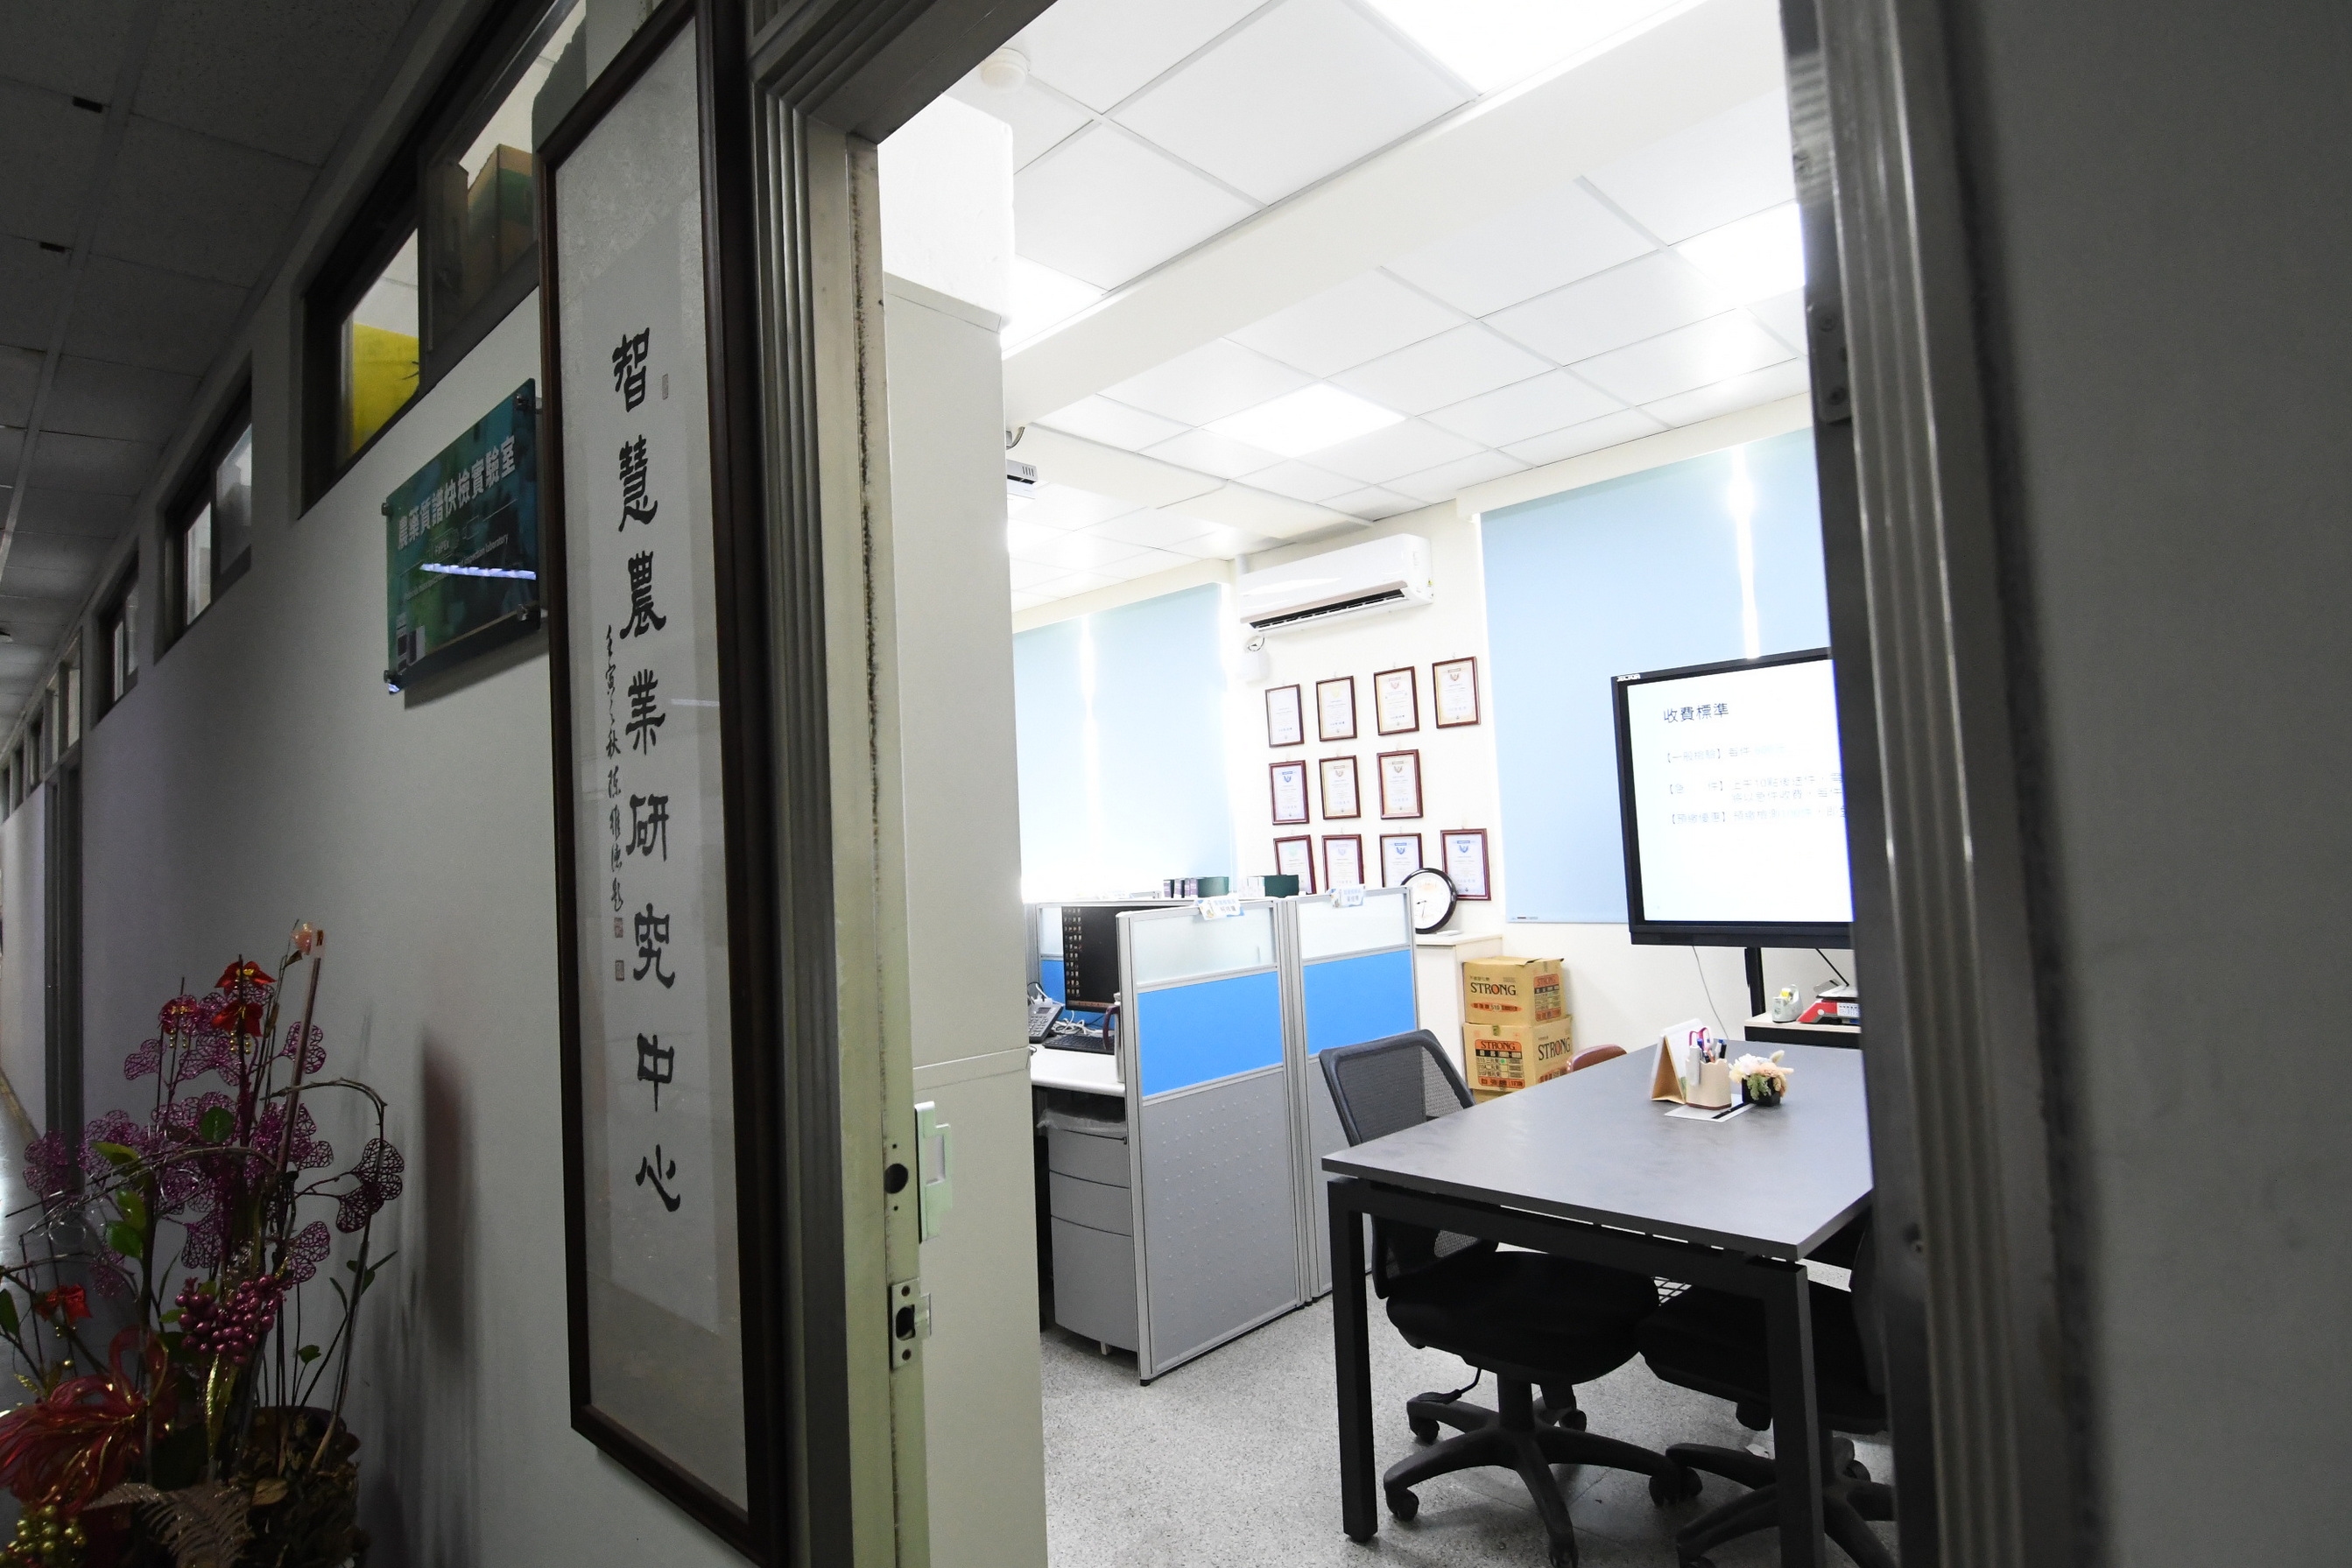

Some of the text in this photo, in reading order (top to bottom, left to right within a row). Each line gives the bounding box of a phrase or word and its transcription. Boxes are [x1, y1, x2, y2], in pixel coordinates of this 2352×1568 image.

[398, 434, 516, 552] 農藥質譜快檢實驗室
[1663, 702, 1729, 723] 收費標準
[611, 327, 681, 1213] 智慧農業研究中心
[1470, 981, 1517, 996] STRONG
[1481, 1041, 1516, 1051] STRONG
[1538, 1037, 1571, 1061] STRONG
